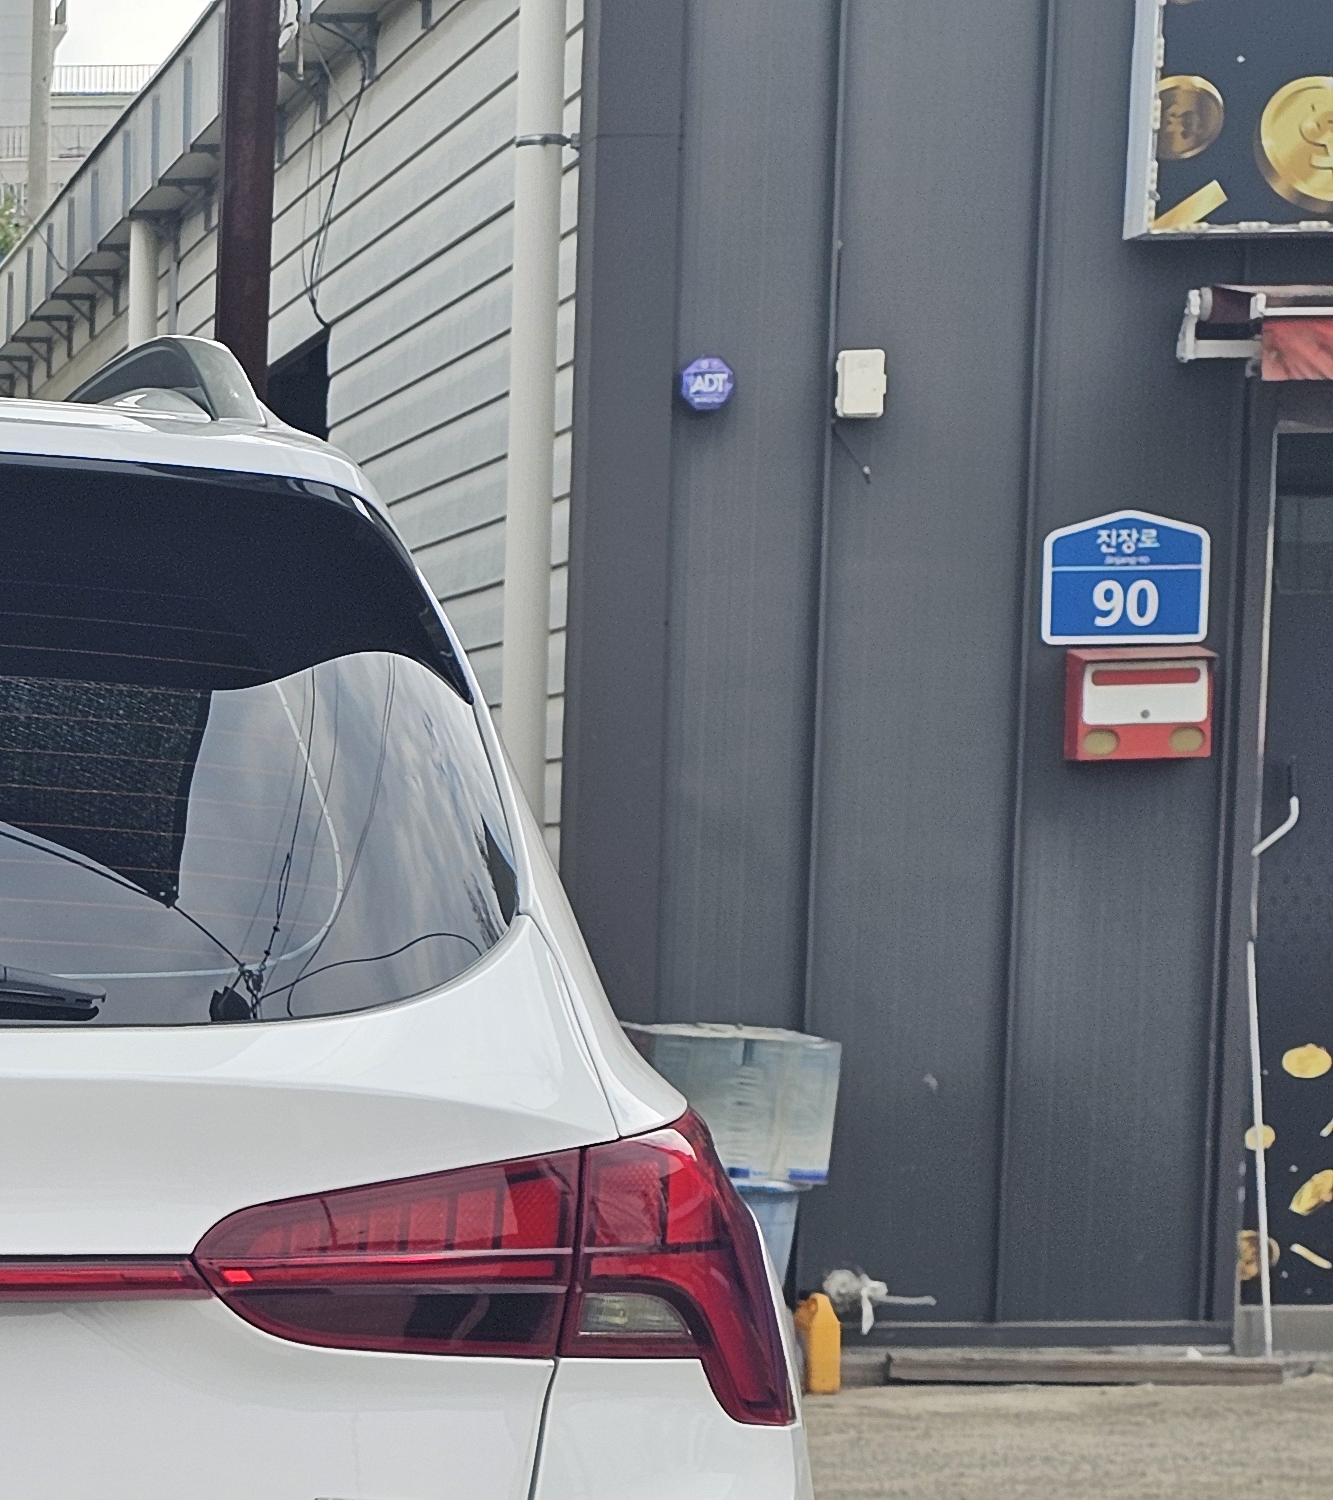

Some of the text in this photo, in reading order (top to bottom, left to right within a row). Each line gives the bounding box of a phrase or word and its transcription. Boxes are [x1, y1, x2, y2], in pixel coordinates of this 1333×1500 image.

[689, 373, 728, 393] ADT
[1096, 527, 1161, 554] 진장로
[1092, 579, 1159, 627] 90
